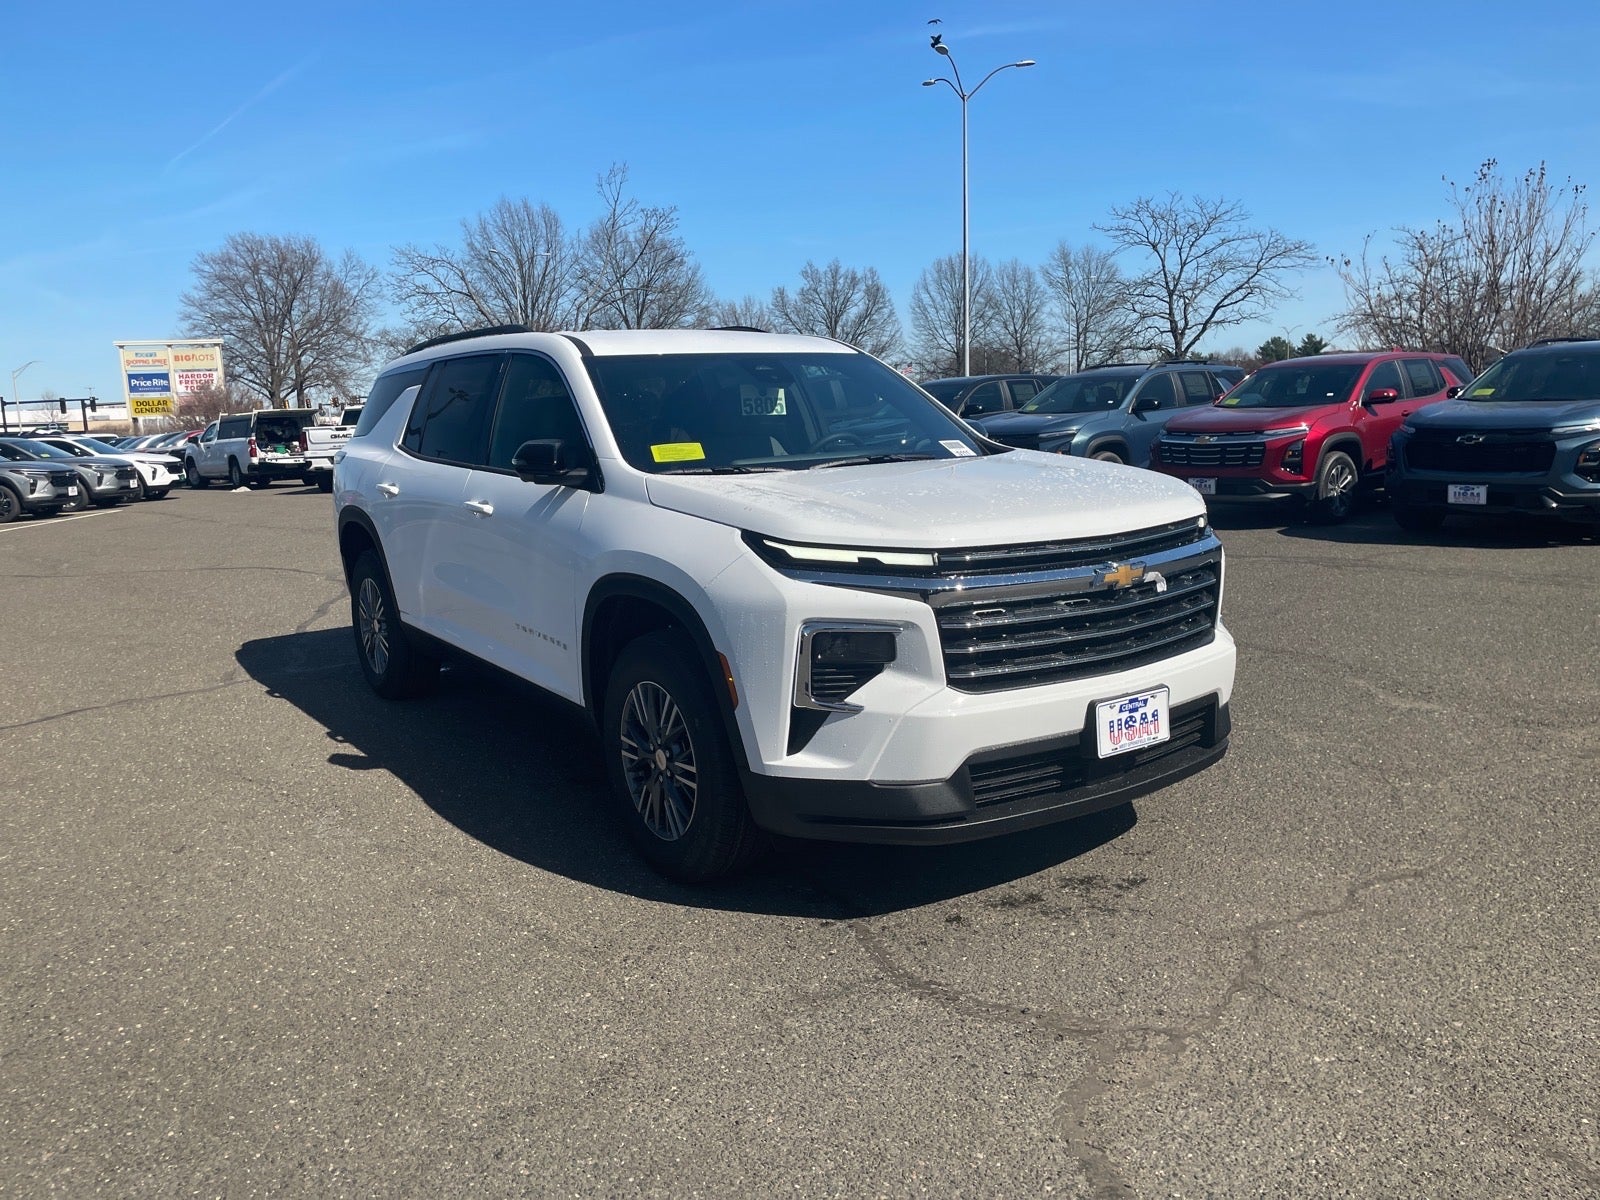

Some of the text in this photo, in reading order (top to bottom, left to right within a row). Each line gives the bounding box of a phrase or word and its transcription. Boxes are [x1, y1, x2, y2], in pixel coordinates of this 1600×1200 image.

[131, 378, 169, 387] Price Rite
[743, 397, 785, 414] 5805
[1121, 700, 1146, 711] CENTRAL
